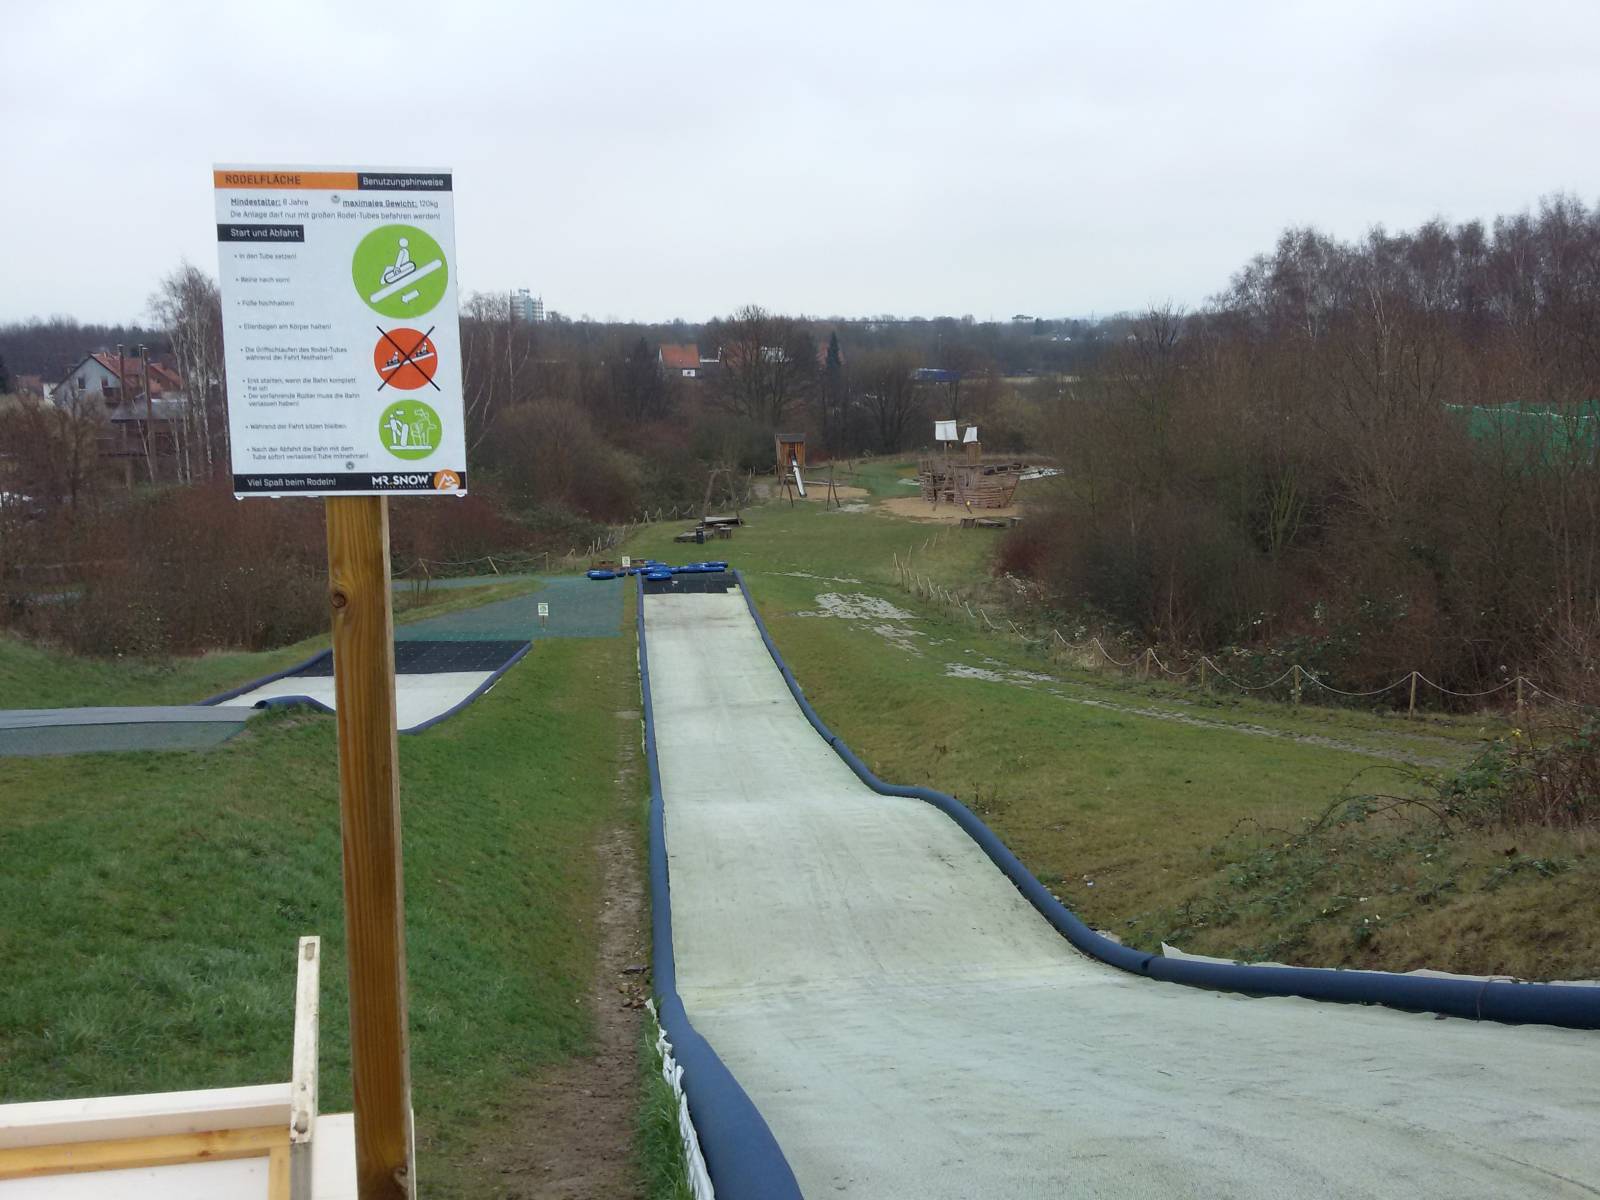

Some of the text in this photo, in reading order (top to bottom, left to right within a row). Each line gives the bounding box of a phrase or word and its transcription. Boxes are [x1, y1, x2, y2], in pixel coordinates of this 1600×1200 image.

[225, 174, 301, 185] RODELFLÄCHE
[362, 177, 444, 187] Benutzungshinweise
[230, 198, 281, 206] Mindestalter:
[289, 198, 309, 206] Jahre
[342, 199, 439, 208] maximales Gewicht: 120kg
[243, 211, 267, 219] Anlage
[337, 211, 379, 219] Rodel-Tubes
[413, 212, 440, 220] werden!
[230, 228, 300, 237] Start und Abfahrt
[247, 478, 337, 488] Viel Spaß beim Rodeln!
